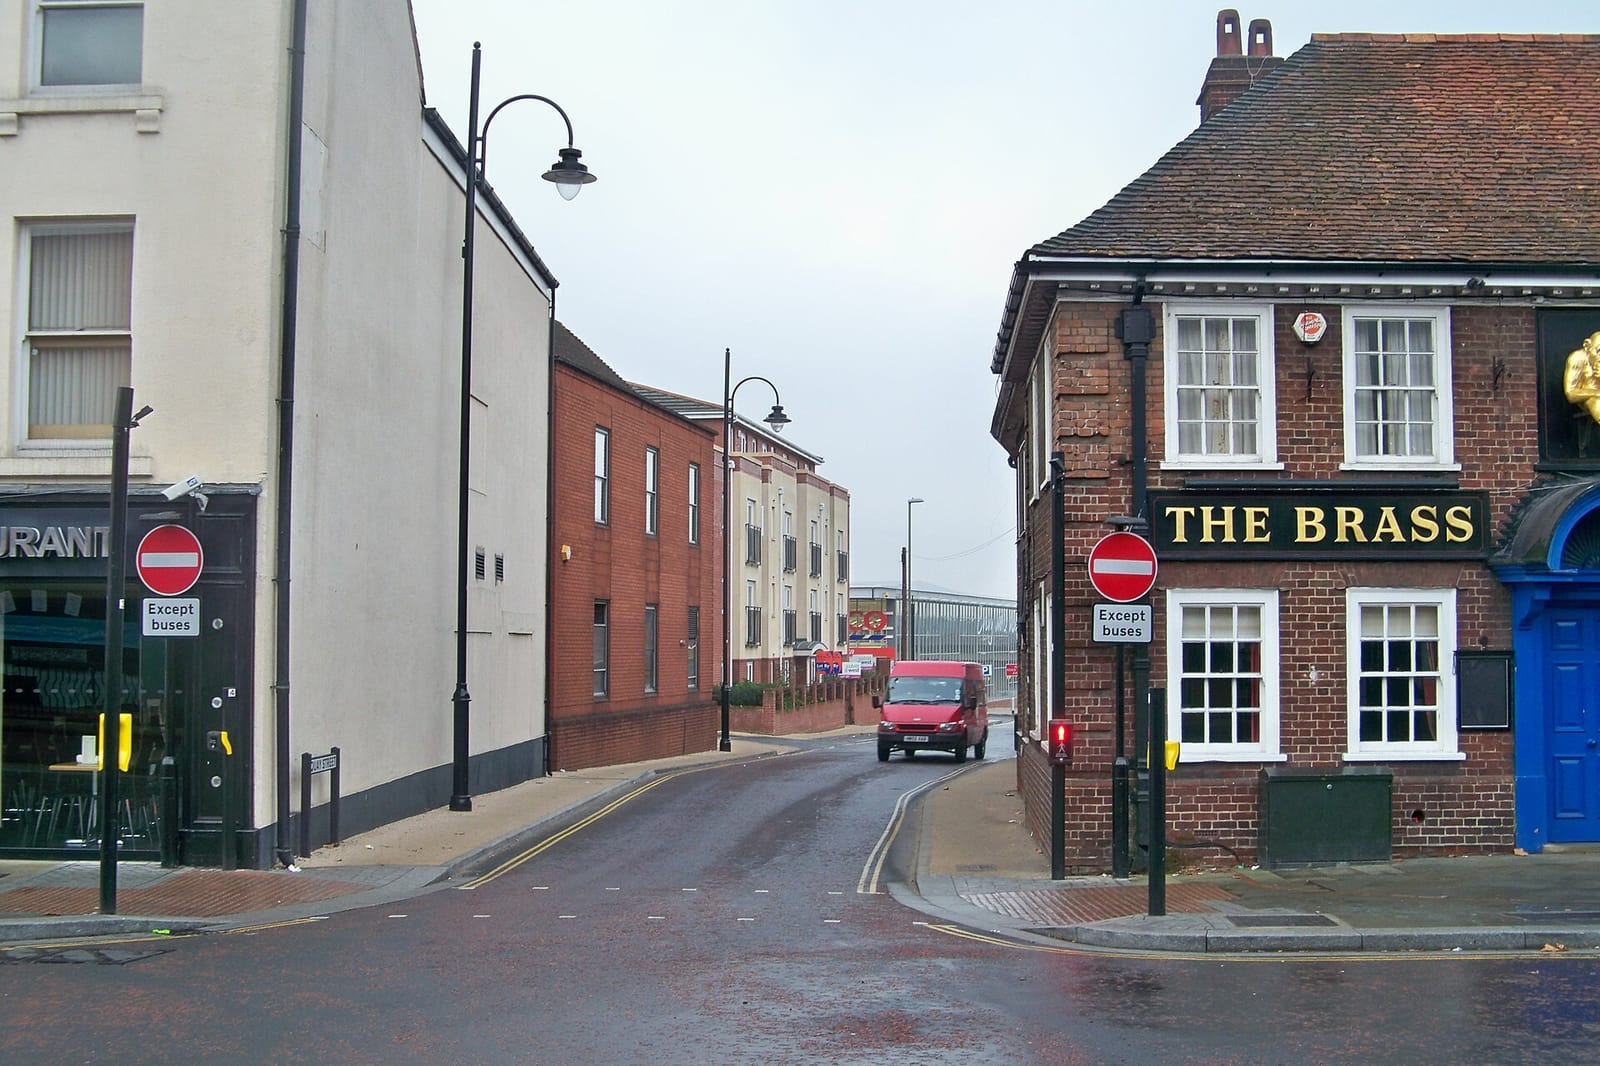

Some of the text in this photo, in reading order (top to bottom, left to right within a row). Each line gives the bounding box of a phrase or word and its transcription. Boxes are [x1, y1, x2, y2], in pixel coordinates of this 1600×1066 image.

[1165, 505, 1474, 543] THE BRASS
[0, 526, 110, 558] RANT
[148, 603, 194, 617] Except
[1099, 609, 1146, 623] Except
[152, 618, 191, 631] buses
[1102, 625, 1142, 637] buses
